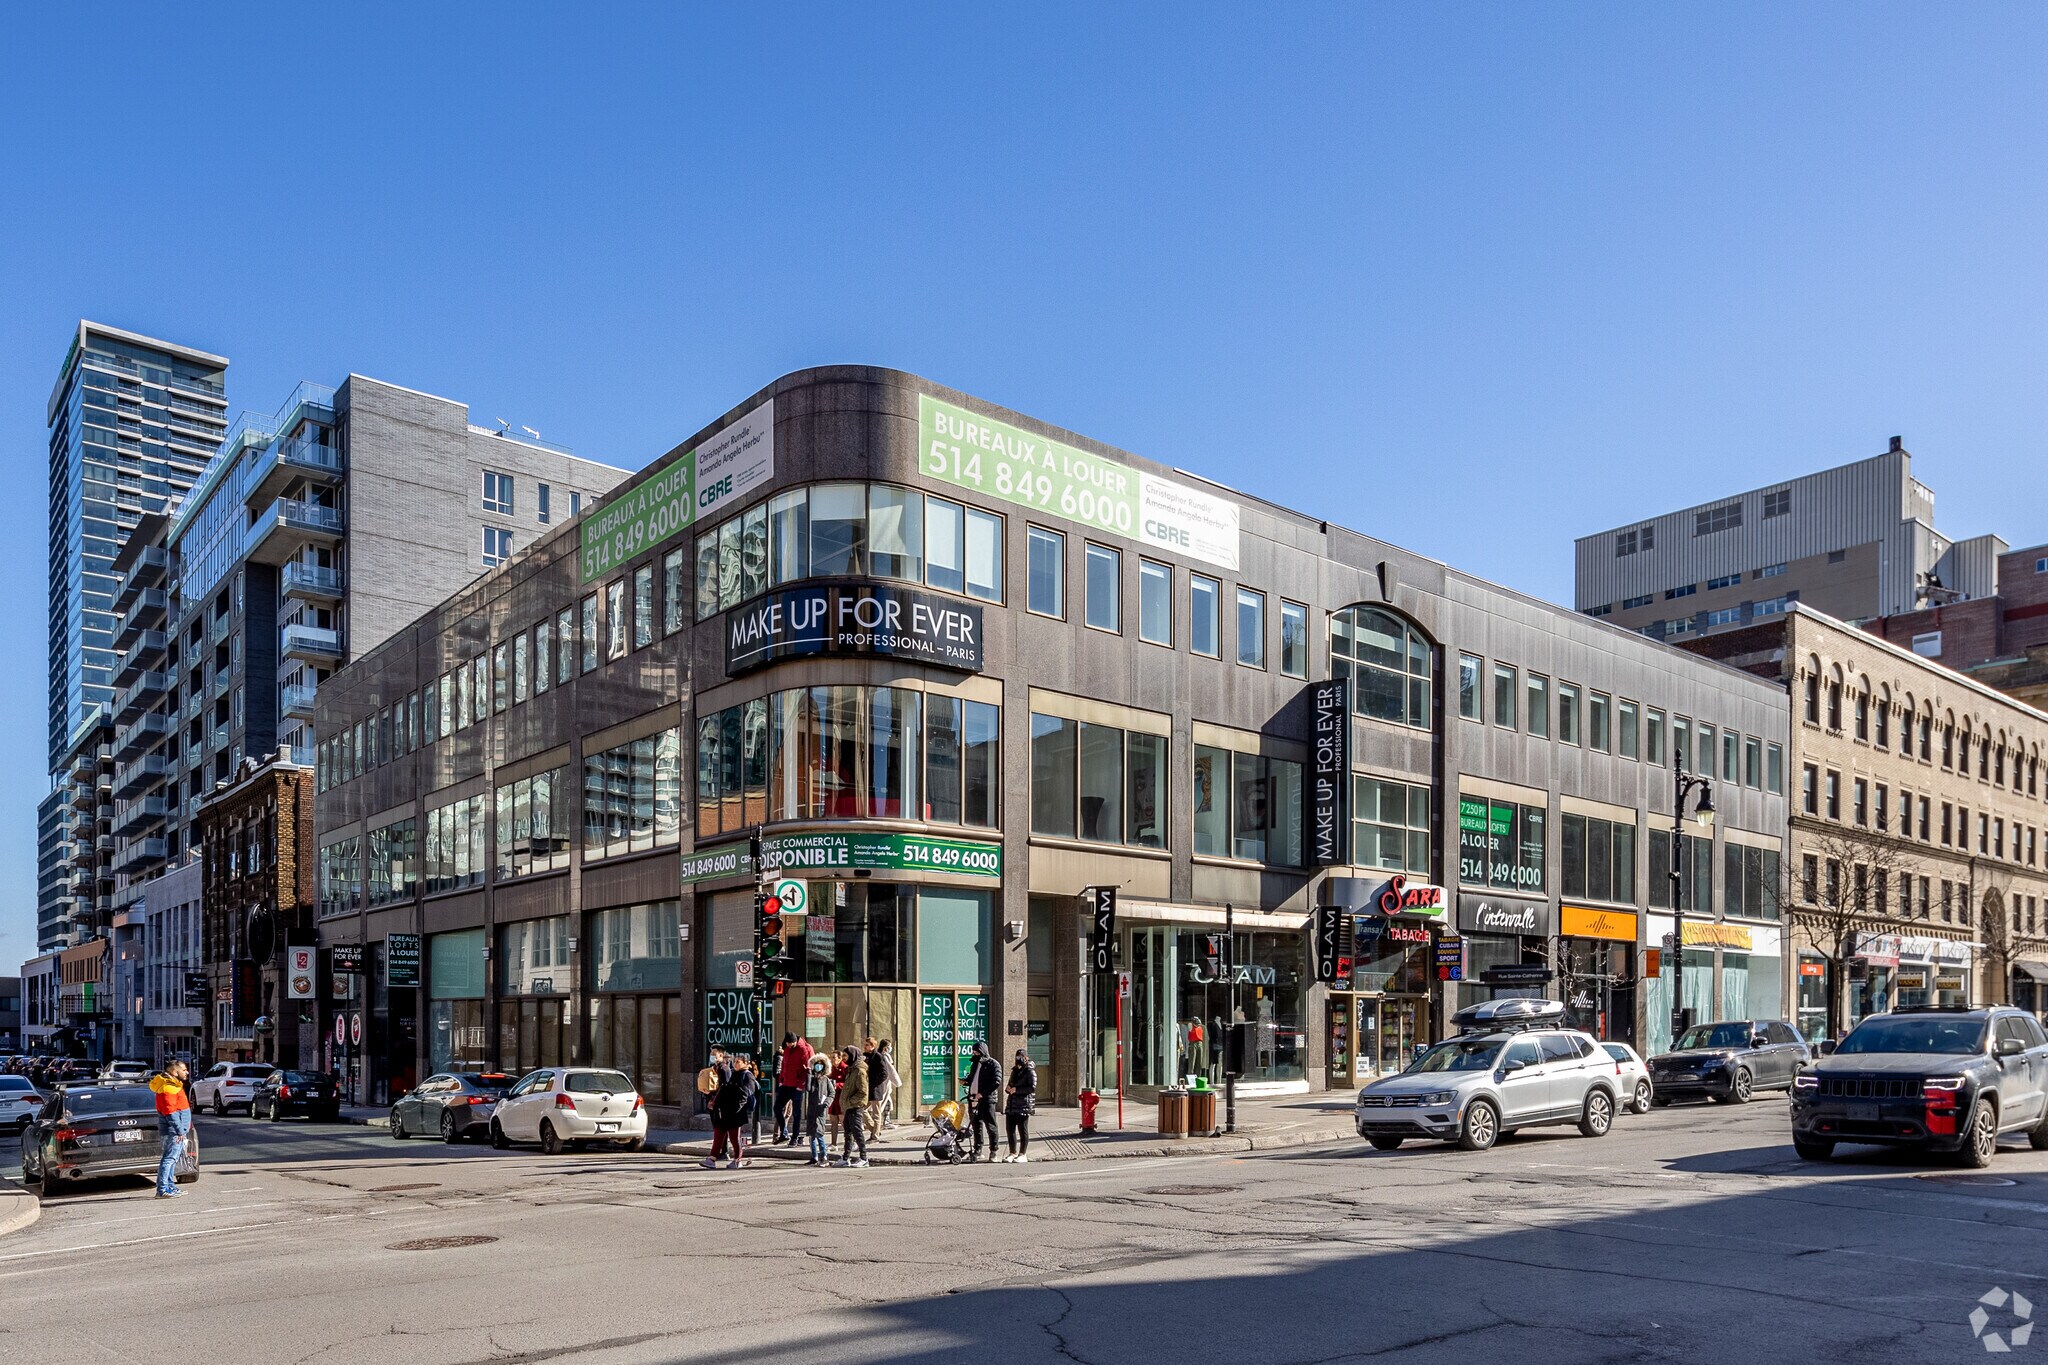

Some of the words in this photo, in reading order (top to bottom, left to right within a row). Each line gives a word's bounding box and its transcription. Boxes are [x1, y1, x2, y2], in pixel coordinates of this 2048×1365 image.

[699, 441, 730, 464] Christopher
[699, 457, 722, 478] Amanda
[722, 448, 742, 466] Angela
[935, 410, 1036, 465] BUREAUX
[1042, 444, 1057, 472] À
[1064, 456, 1127, 495] LOUER
[700, 474, 733, 508] CBRE
[929, 440, 982, 486] 514
[995, 463, 1053, 505] 849
[1060, 485, 1131, 532] 6000
[1145, 484, 1187, 506] Christopher
[588, 499, 635, 544] BUREAUX
[637, 488, 647, 514] À
[649, 466, 687, 507] LOUER
[1145, 497, 1177, 514] Amanda
[1177, 506, 1202, 523] Angela
[585, 539, 610, 578] 514
[615, 520, 644, 560] 849
[648, 492, 690, 542] 6000
[1145, 519, 1190, 547] CBRE
[731, 603, 782, 650] MAKE
[790, 598, 827, 630] UP
[839, 598, 902, 630] FOR
[912, 603, 975, 644] EVER
[838, 633, 935, 654] PROFESSIONAL
[946, 645, 975, 661] PARIS
[1317, 687, 1333, 732] EVER
[1317, 736, 1332, 773] FOR
[1317, 778, 1332, 801] UP
[763, 840, 780, 851] SPACE
[783, 837, 848, 848] COMMERCIAL
[1317, 806, 1333, 859] MAKE
[1460, 830, 1468, 846] À
[1470, 834, 1500, 851] LOUER
[682, 861, 696, 877] 514
[697, 859, 713, 875] 849
[714, 854, 736, 872] 6000
[761, 848, 848, 869] DISPONIBLE
[903, 845, 929, 862] 514
[932, 848, 959, 866] 849
[962, 851, 998, 869] 6000
[1460, 858, 1483, 878] 514
[1510, 865, 1541, 886] 6000
[1355, 924, 1383, 935] Transax
[1475, 902, 1535, 929] l'intervalle
[1098, 891, 1111, 969] OLAM
[1322, 910, 1335, 978] OLAM
[1391, 928, 1429, 942] TABAGIE
[708, 1028, 773, 1044] COMMERAL
[923, 1045, 939, 1056] 514
